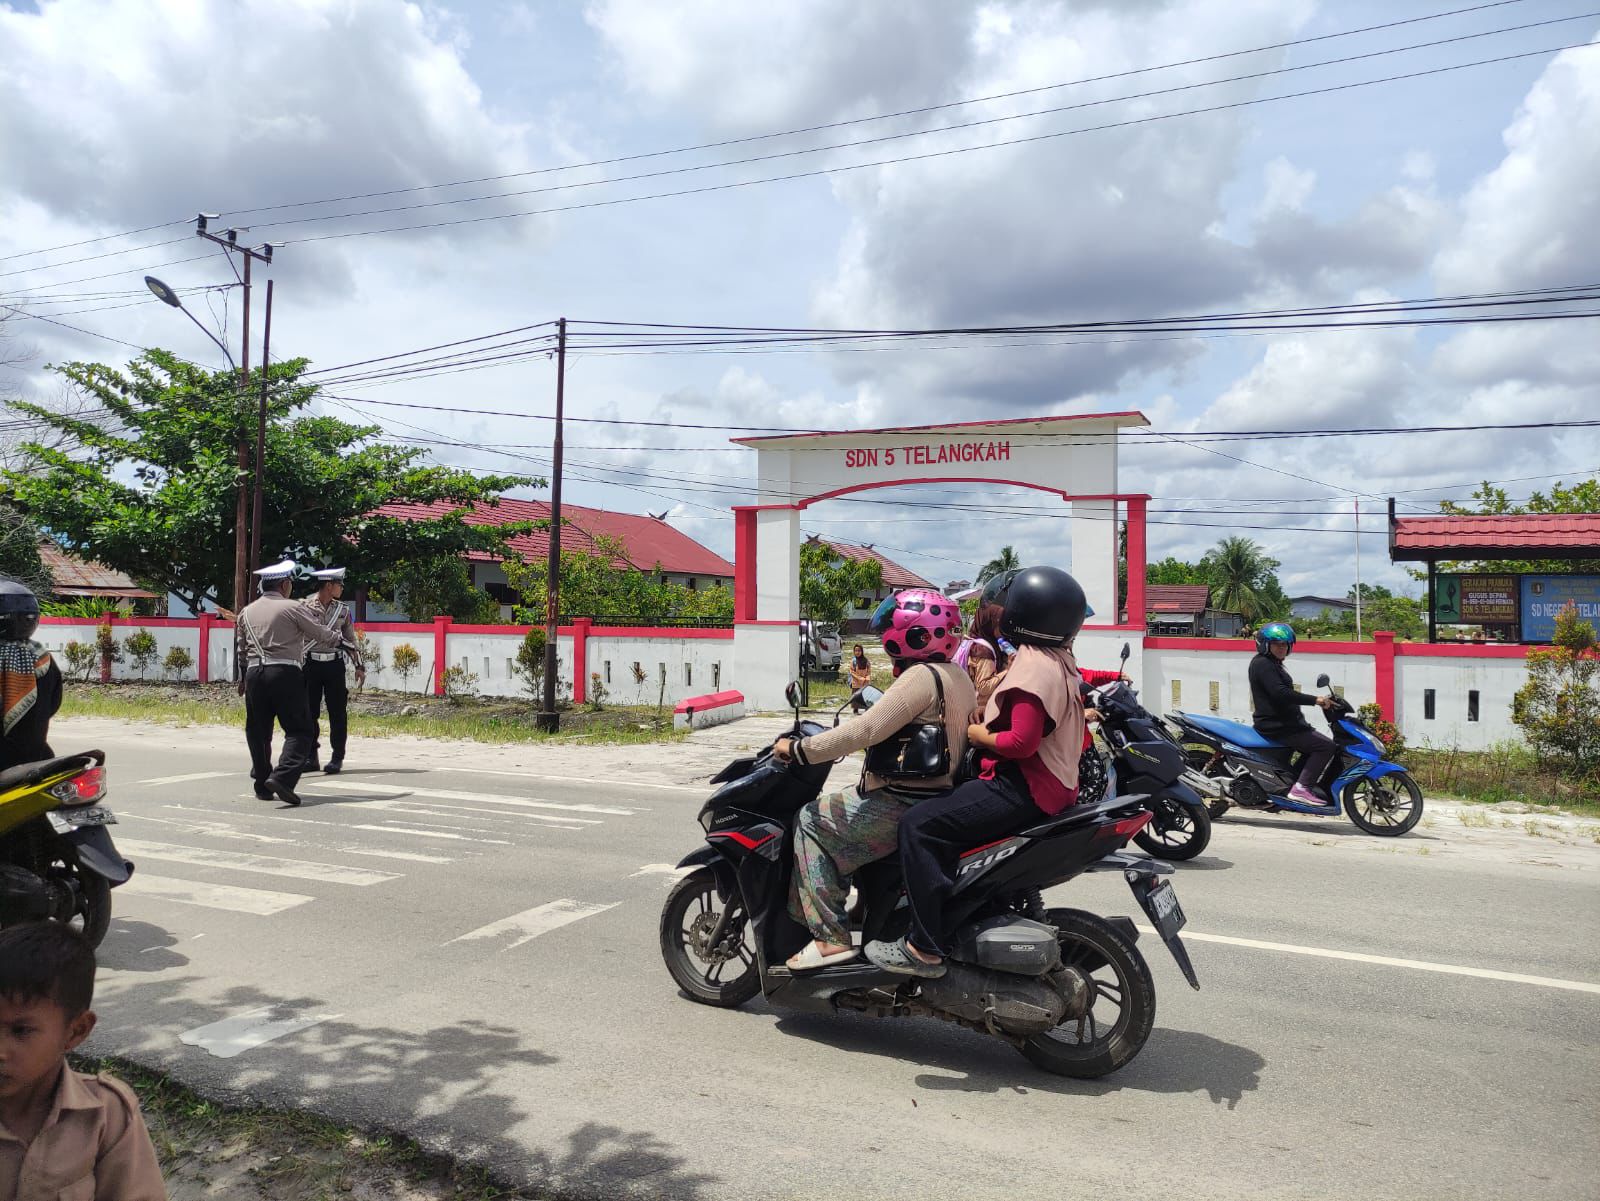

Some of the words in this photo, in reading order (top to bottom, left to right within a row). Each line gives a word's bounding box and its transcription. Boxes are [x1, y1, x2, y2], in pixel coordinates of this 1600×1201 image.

[846, 448, 878, 468] SDN
[884, 448, 895, 466] 5
[903, 441, 1010, 465] TELANGKAH
[1531, 603, 1543, 617] SD
[714, 813, 739, 825] HONDA
[956, 846, 1017, 878] RIO
